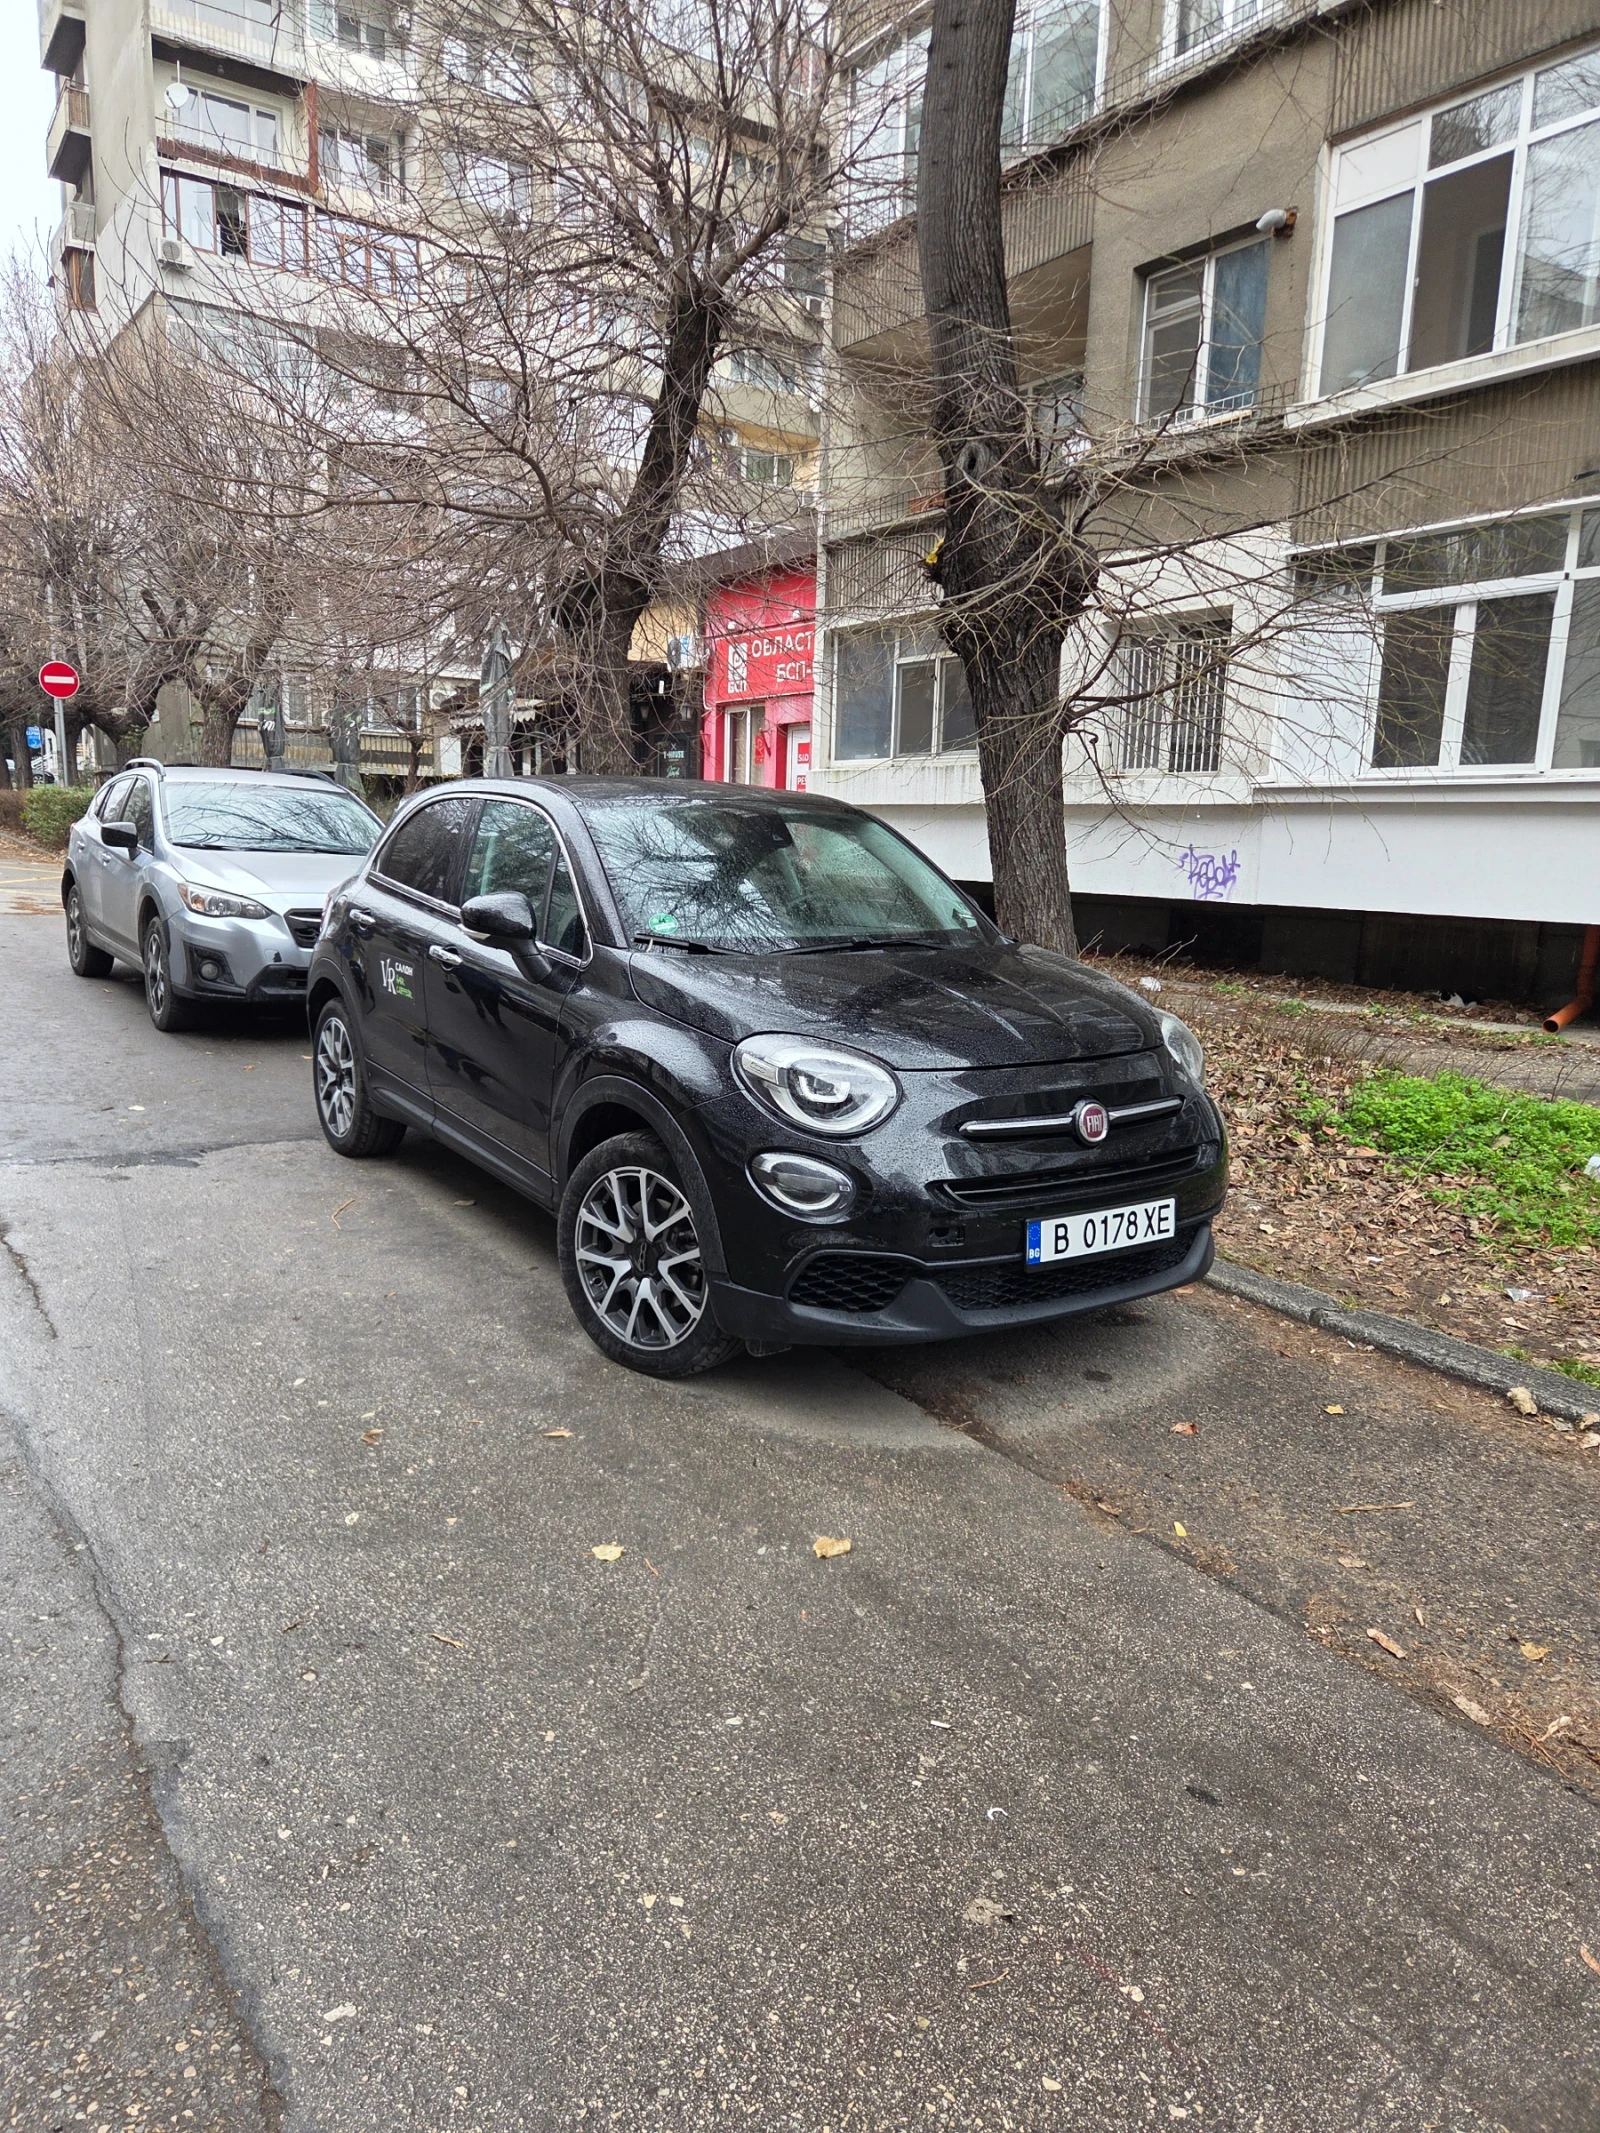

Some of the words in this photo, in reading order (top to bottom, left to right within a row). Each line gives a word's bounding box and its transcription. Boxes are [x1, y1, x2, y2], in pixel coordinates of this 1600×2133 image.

[380, 957, 397, 995] VR
[1086, 1114, 1103, 1133] FIAT
[1054, 1223, 1069, 1254] B
[1083, 1211, 1138, 1248] 0178
[1143, 1204, 1171, 1238] XE
[1029, 1248, 1040, 1259] BG
